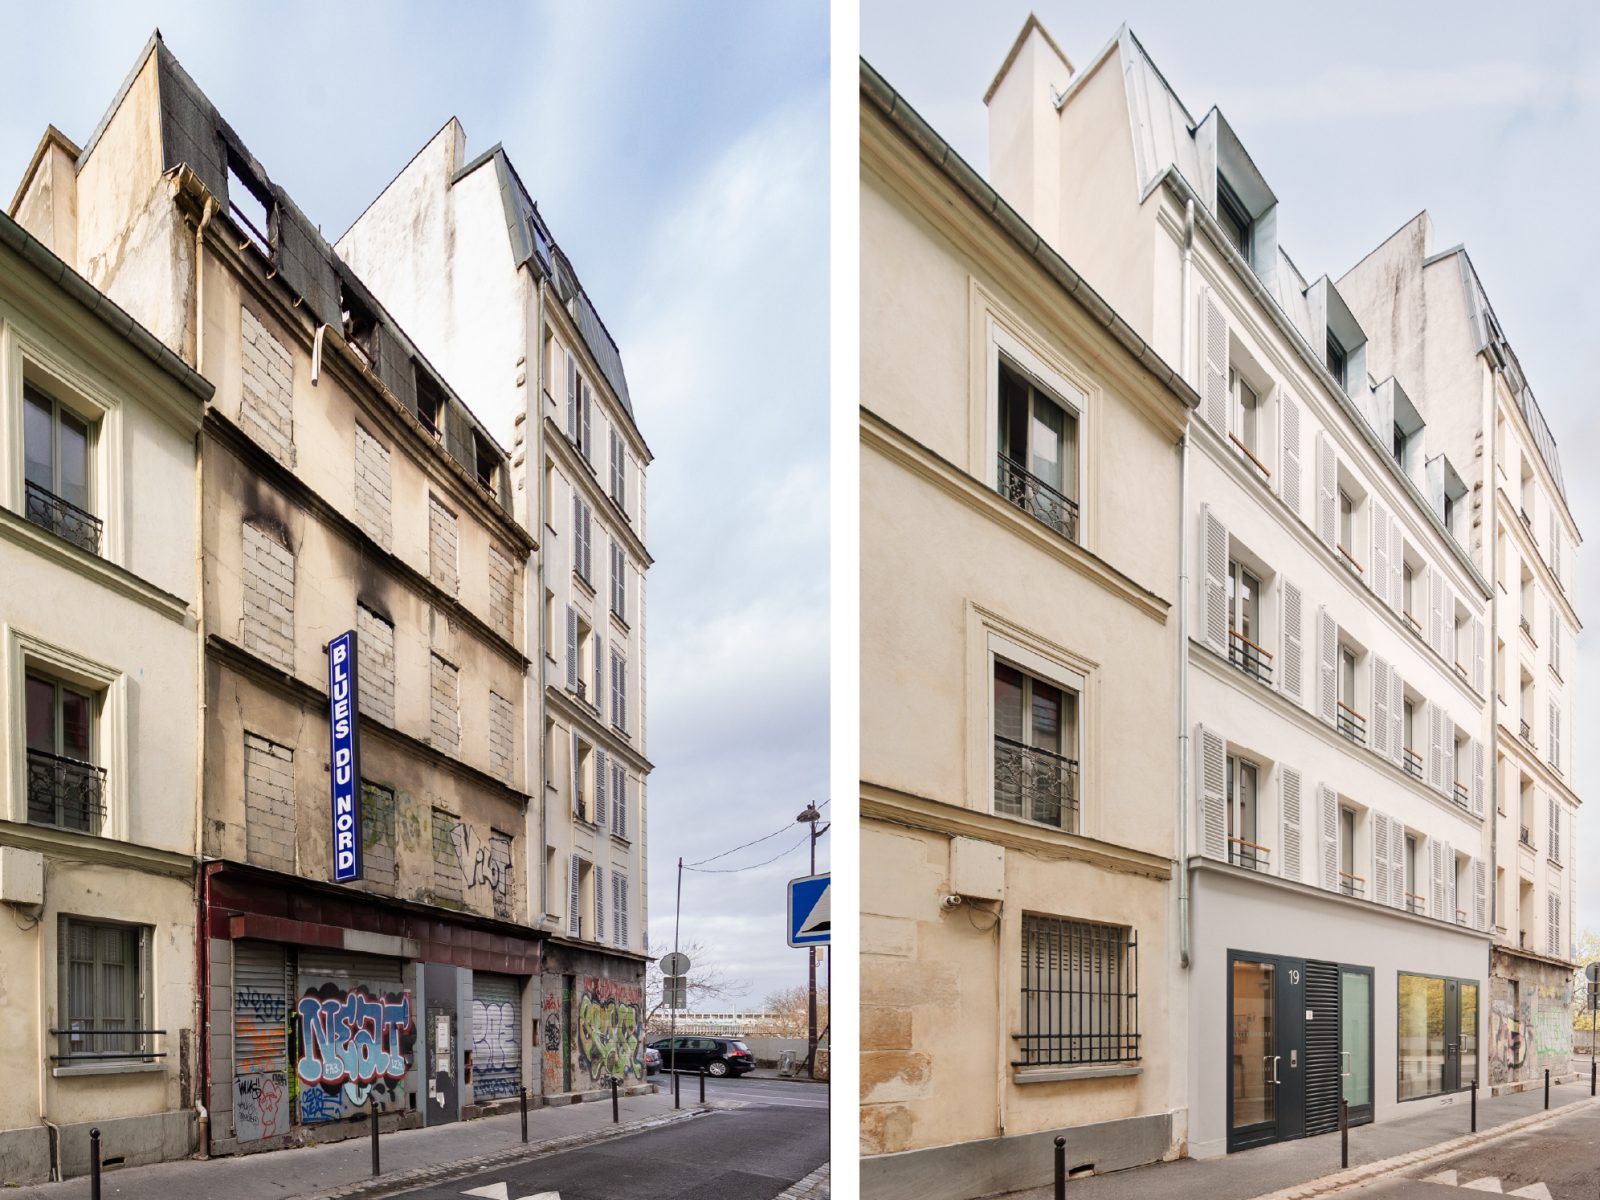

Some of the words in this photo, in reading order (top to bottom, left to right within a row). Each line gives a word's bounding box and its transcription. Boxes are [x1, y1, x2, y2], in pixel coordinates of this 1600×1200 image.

[333, 643, 349, 739] BLUES
[336, 747, 350, 785] DU
[337, 794, 354, 870] NORD
[1288, 969, 1300, 985] 19
